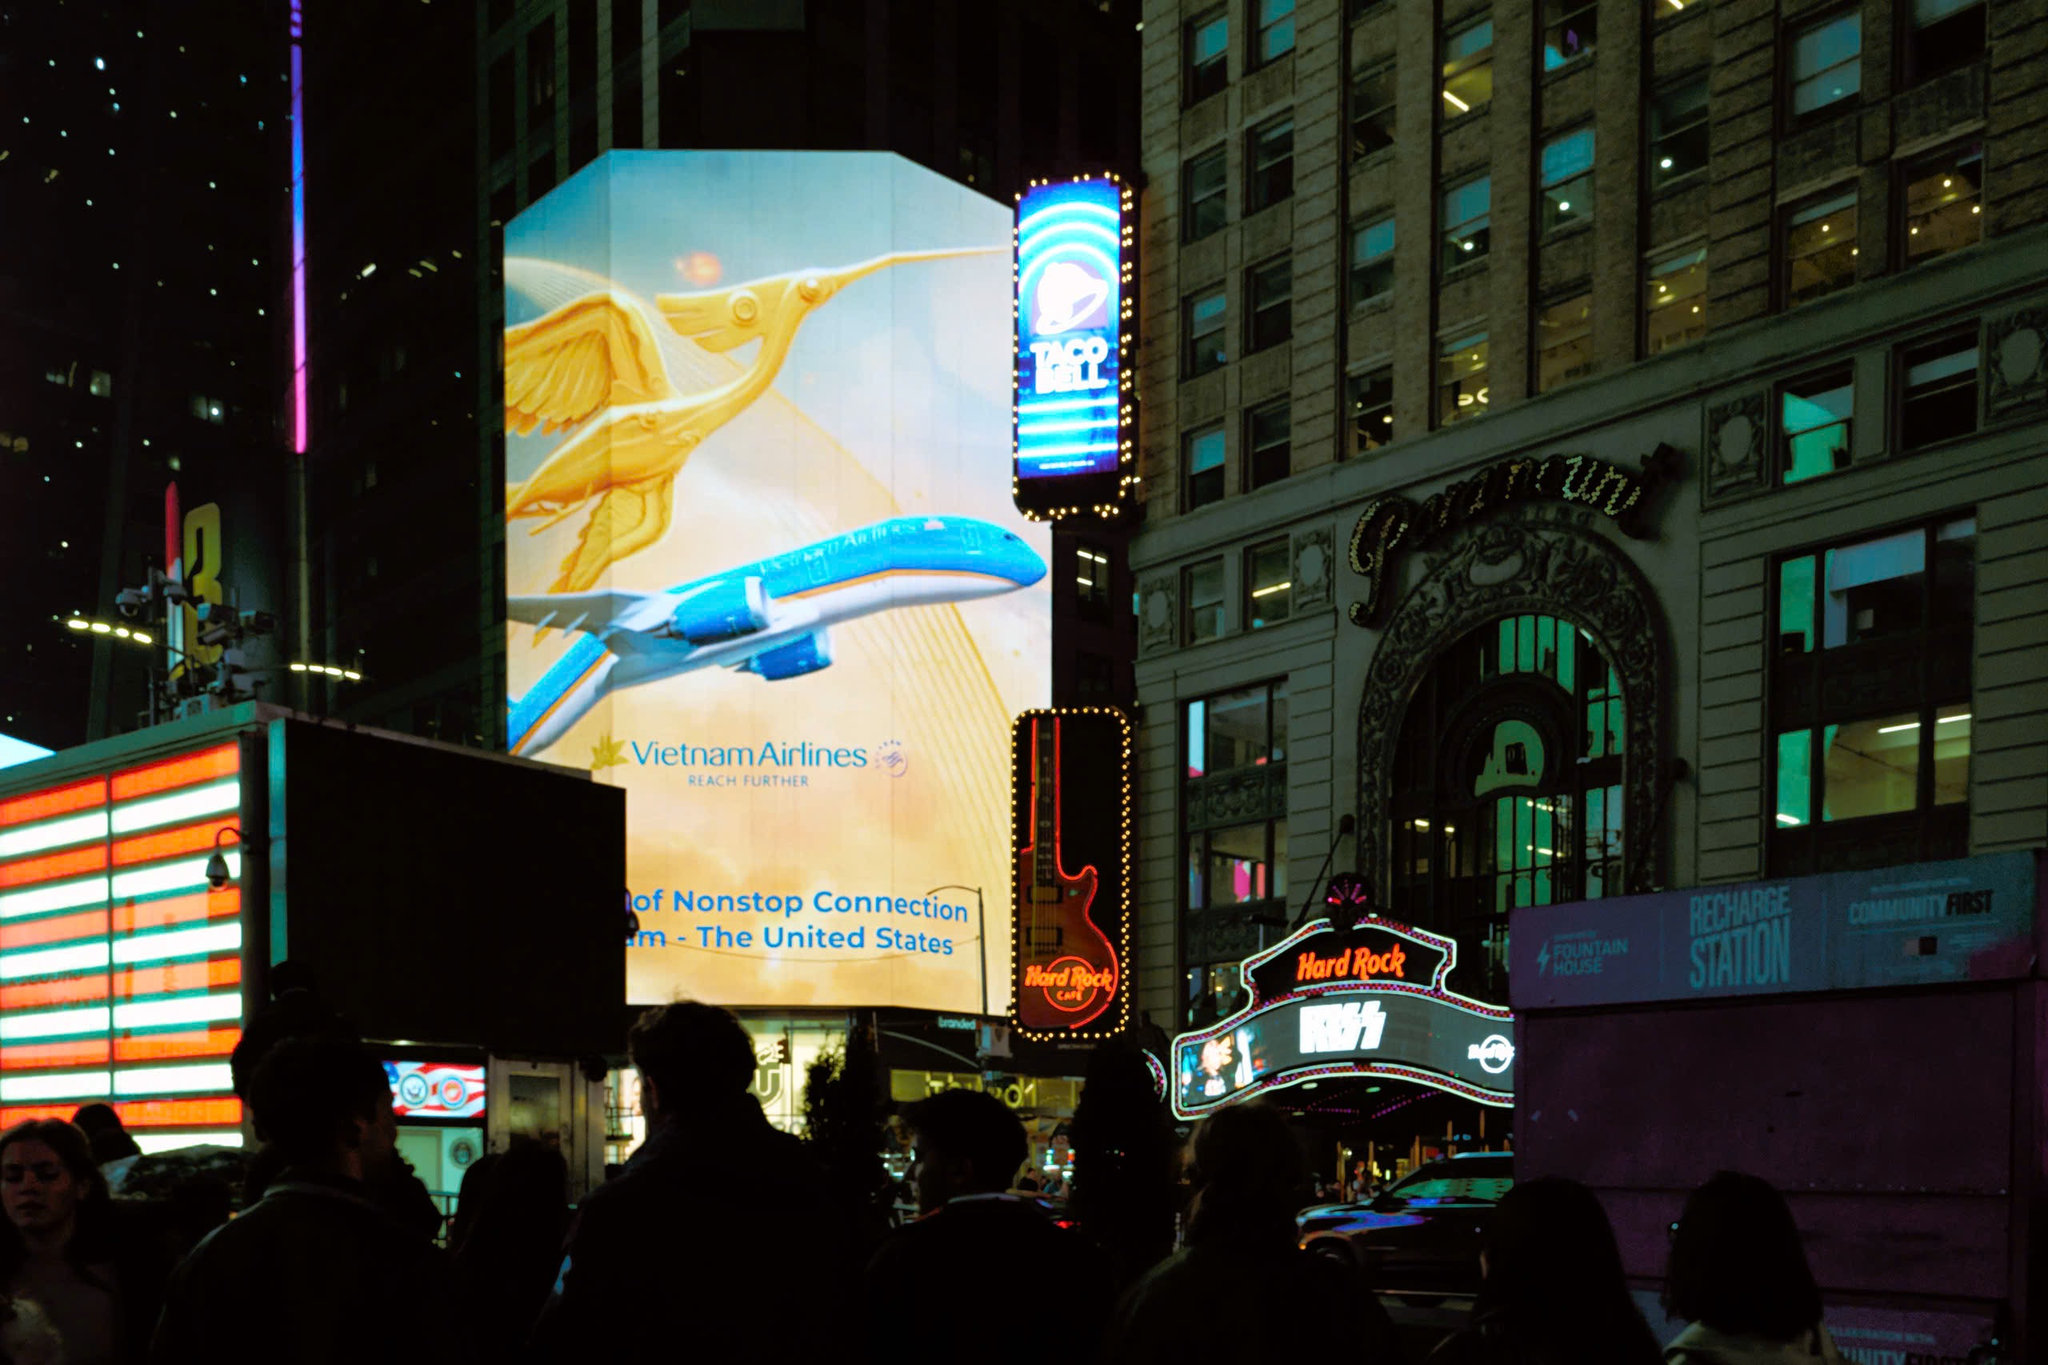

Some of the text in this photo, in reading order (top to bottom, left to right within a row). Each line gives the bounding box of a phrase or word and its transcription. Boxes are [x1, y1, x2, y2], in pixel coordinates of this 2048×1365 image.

[1030, 337, 1108, 368] TACO
[1035, 366, 1109, 393] BELL
[632, 741, 755, 766] Vietnam
[760, 742, 868, 767] Airlines
[688, 775, 808, 787] REACH FURTHER
[632, 890, 969, 922] of Nonstop Connection
[1689, 885, 1791, 937] RECHARGE
[697, 925, 753, 948] The
[763, 925, 866, 948] United
[876, 927, 953, 955] States
[1553, 938, 1629, 959] FOUNTAIN
[1689, 917, 1791, 989] STATION
[1297, 943, 1406, 981] Hard Rock
[1553, 957, 1604, 976] HOUSE
[1024, 965, 1113, 992] Hard Rock
